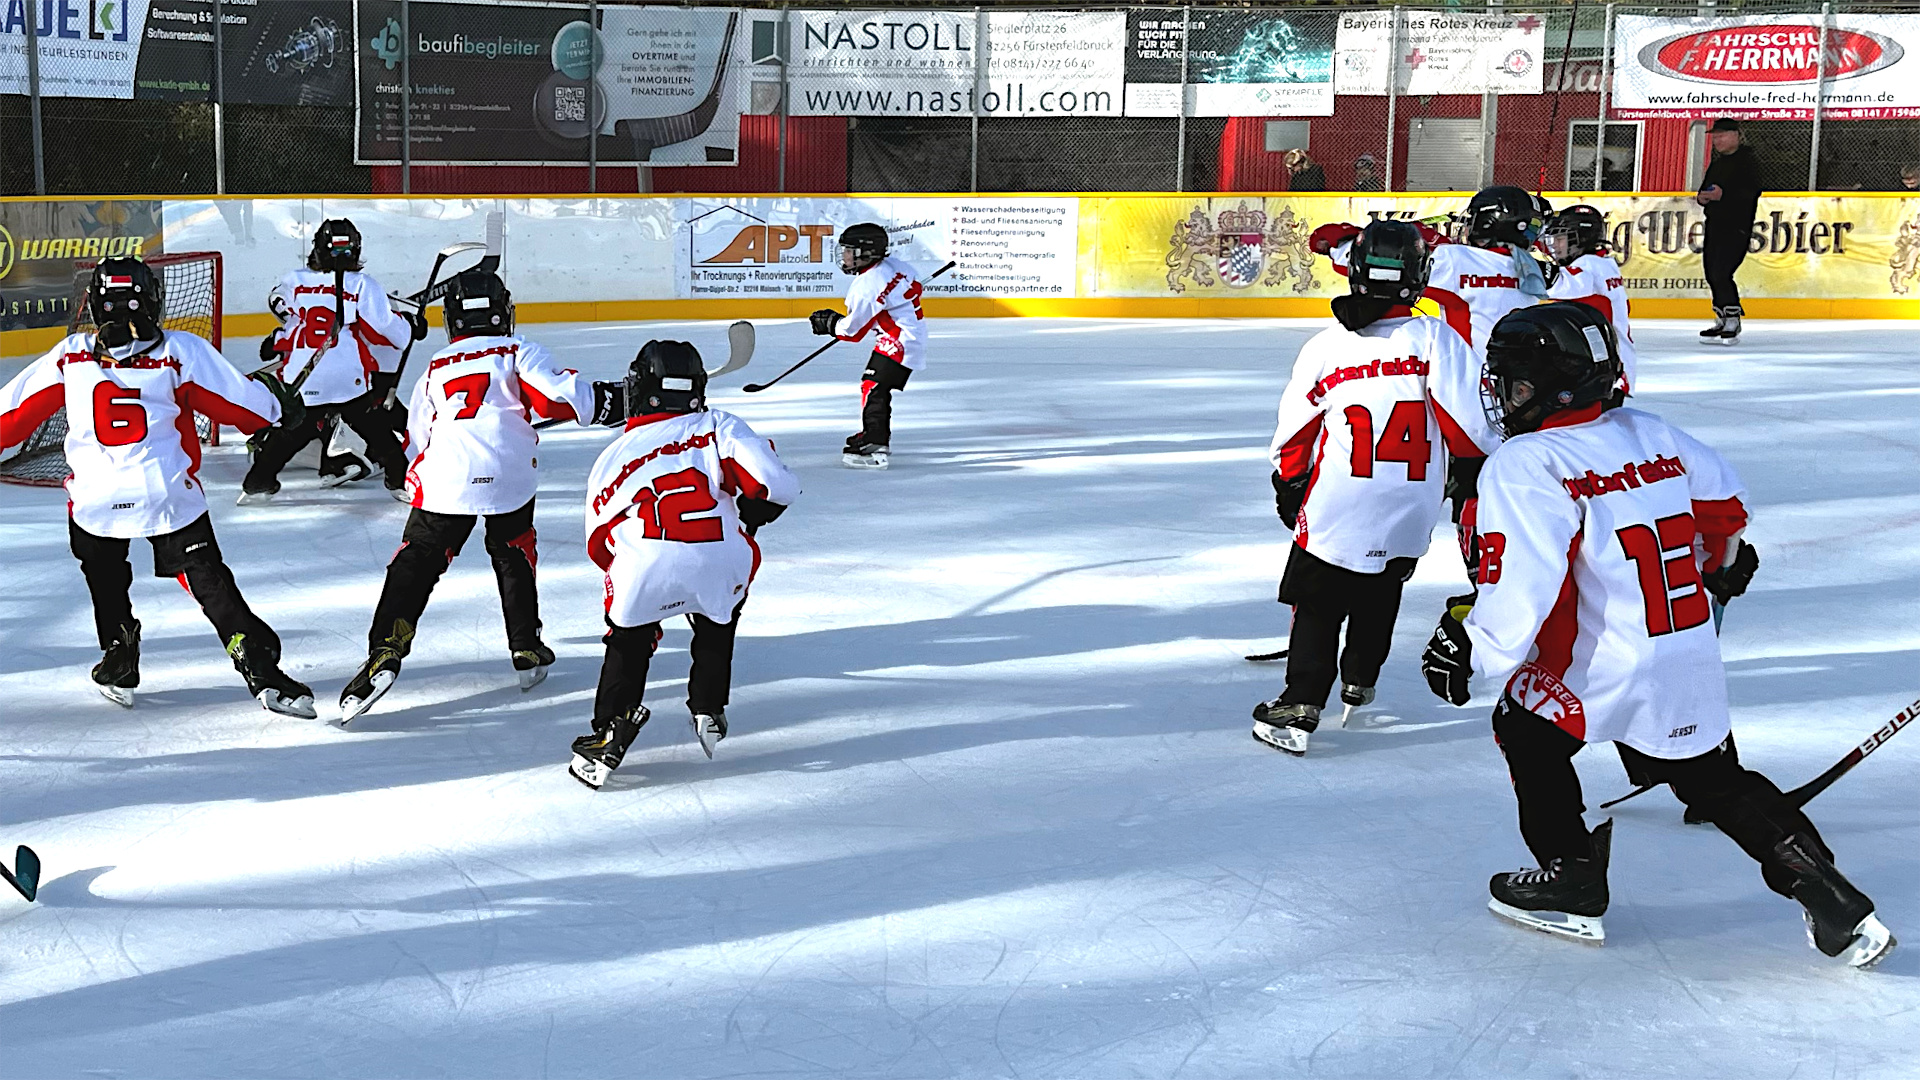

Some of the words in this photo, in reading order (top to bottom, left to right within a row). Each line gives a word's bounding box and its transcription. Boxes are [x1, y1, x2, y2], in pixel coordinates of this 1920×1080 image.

[152, 8, 198, 24] Berechnung
[199, 11, 207, 22] &
[1053, 23, 1067, 33] 26
[1139, 21, 1158, 30] WIR
[1161, 21, 1206, 30] MACEN
[1343, 17, 1425, 32] Bayerishes
[1429, 17, 1469, 29] Rotes
[1472, 18, 1513, 30] Kreuz
[627, 28, 648, 37] Gern
[804, 22, 971, 51] NASTOLL
[1138, 30, 1167, 39] EUCH
[418, 33, 541, 60] baufibegleiter
[1137, 38, 1157, 49] FÜR
[1160, 40, 1176, 49] DIE
[632, 52, 678, 61] OVERTIME
[803, 57, 879, 68] einrichten
[887, 57, 912, 67] und
[919, 58, 972, 68] wohnen
[634, 75, 695, 84] IMMOBILIEN-
[631, 87, 696, 97] FINANZIERUNG
[805, 82, 1112, 113] www.nastoll.com
[1617, 109, 1692, 119] Fürstenfeldbruck
[1700, 109, 1759, 120] Landsberger
[1761, 109, 1792, 119] Straße
[1794, 109, 1807, 118] 32
[1819, 108, 1849, 118] elefon
[1850, 108, 1880, 118] 08141
[960, 205, 1067, 215] Wasserschadenbeseitigung
[981, 217, 996, 225] und
[997, 217, 1063, 227] Fliesensanierung
[960, 228, 1046, 238] Fliesenfugenreinigung
[20, 235, 145, 261] WARRIOR
[698, 224, 834, 264] APT
[960, 239, 1009, 249] Renovierung
[959, 263, 1013, 271] Bautrocknung
[691, 270, 702, 281] Ihr
[703, 270, 746, 283] Trocknungs
[754, 270, 833, 283] Renovierungspartner
[959, 273, 1041, 282] Schimmelbeseitigung
[922, 283, 1063, 296] www.apt-trocknungspartner.de
[1663, 278, 1709, 290] HOHE
[442, 371, 491, 421] 7
[92, 380, 149, 447] 6
[1343, 400, 1432, 482] 14
[631, 466, 725, 544] 12
[1614, 511, 1711, 638] 13
